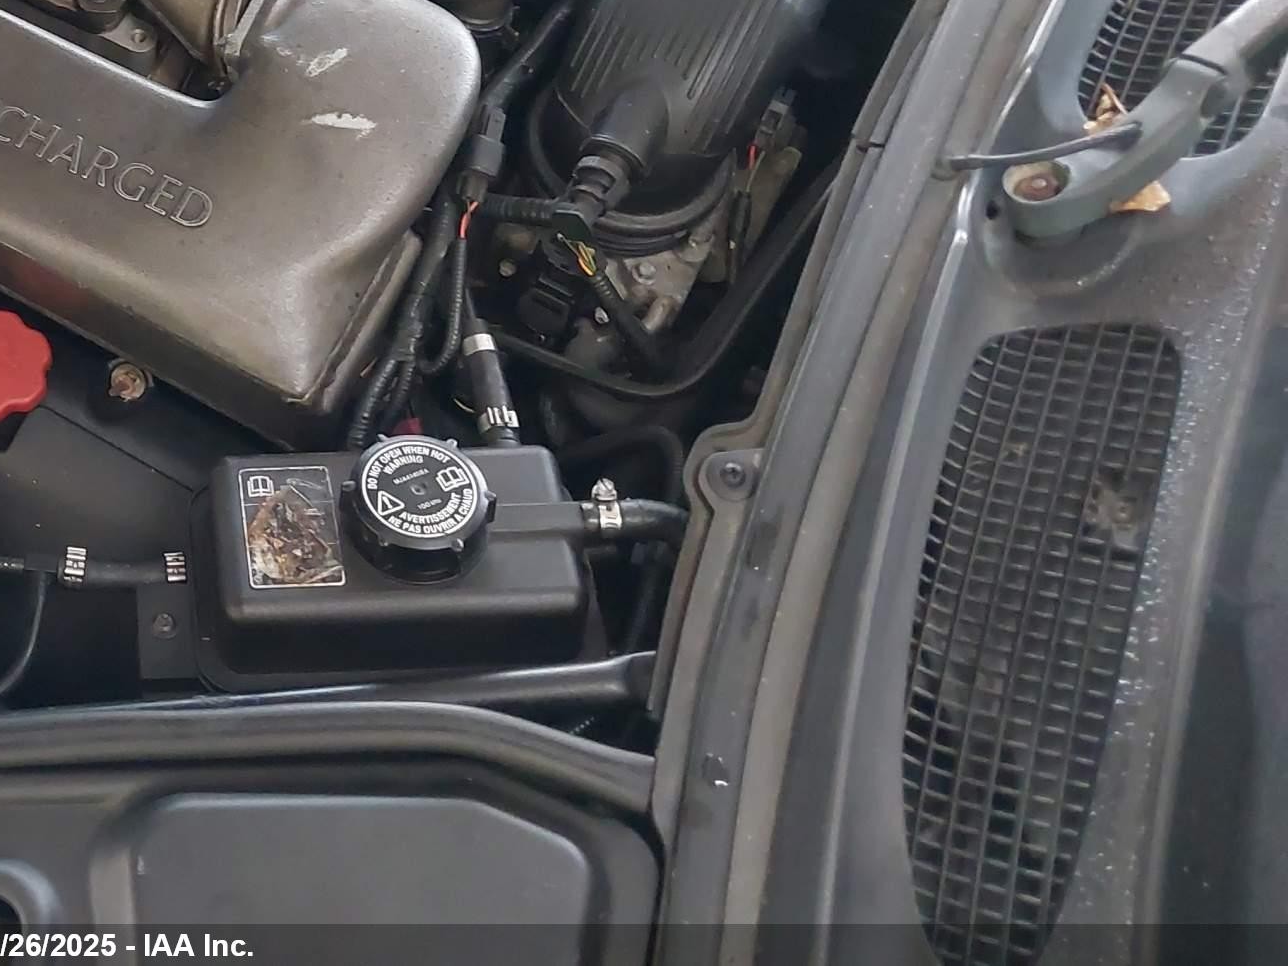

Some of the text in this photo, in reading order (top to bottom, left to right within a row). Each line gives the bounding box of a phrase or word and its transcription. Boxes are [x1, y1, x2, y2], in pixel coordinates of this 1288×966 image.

[380, 447, 403, 464] OPEN
[402, 445, 429, 455] WHEN
[369, 460, 383, 478] NOT
[383, 455, 424, 475] WARNING
[367, 477, 378, 490] DO
[388, 515, 403, 528] NE
[402, 522, 421, 533] PAS
[423, 518, 457, 533] OUVRIR
[458, 488, 473, 515] CHAUD
[399, 492, 461, 524] AVERTISSEMENT
